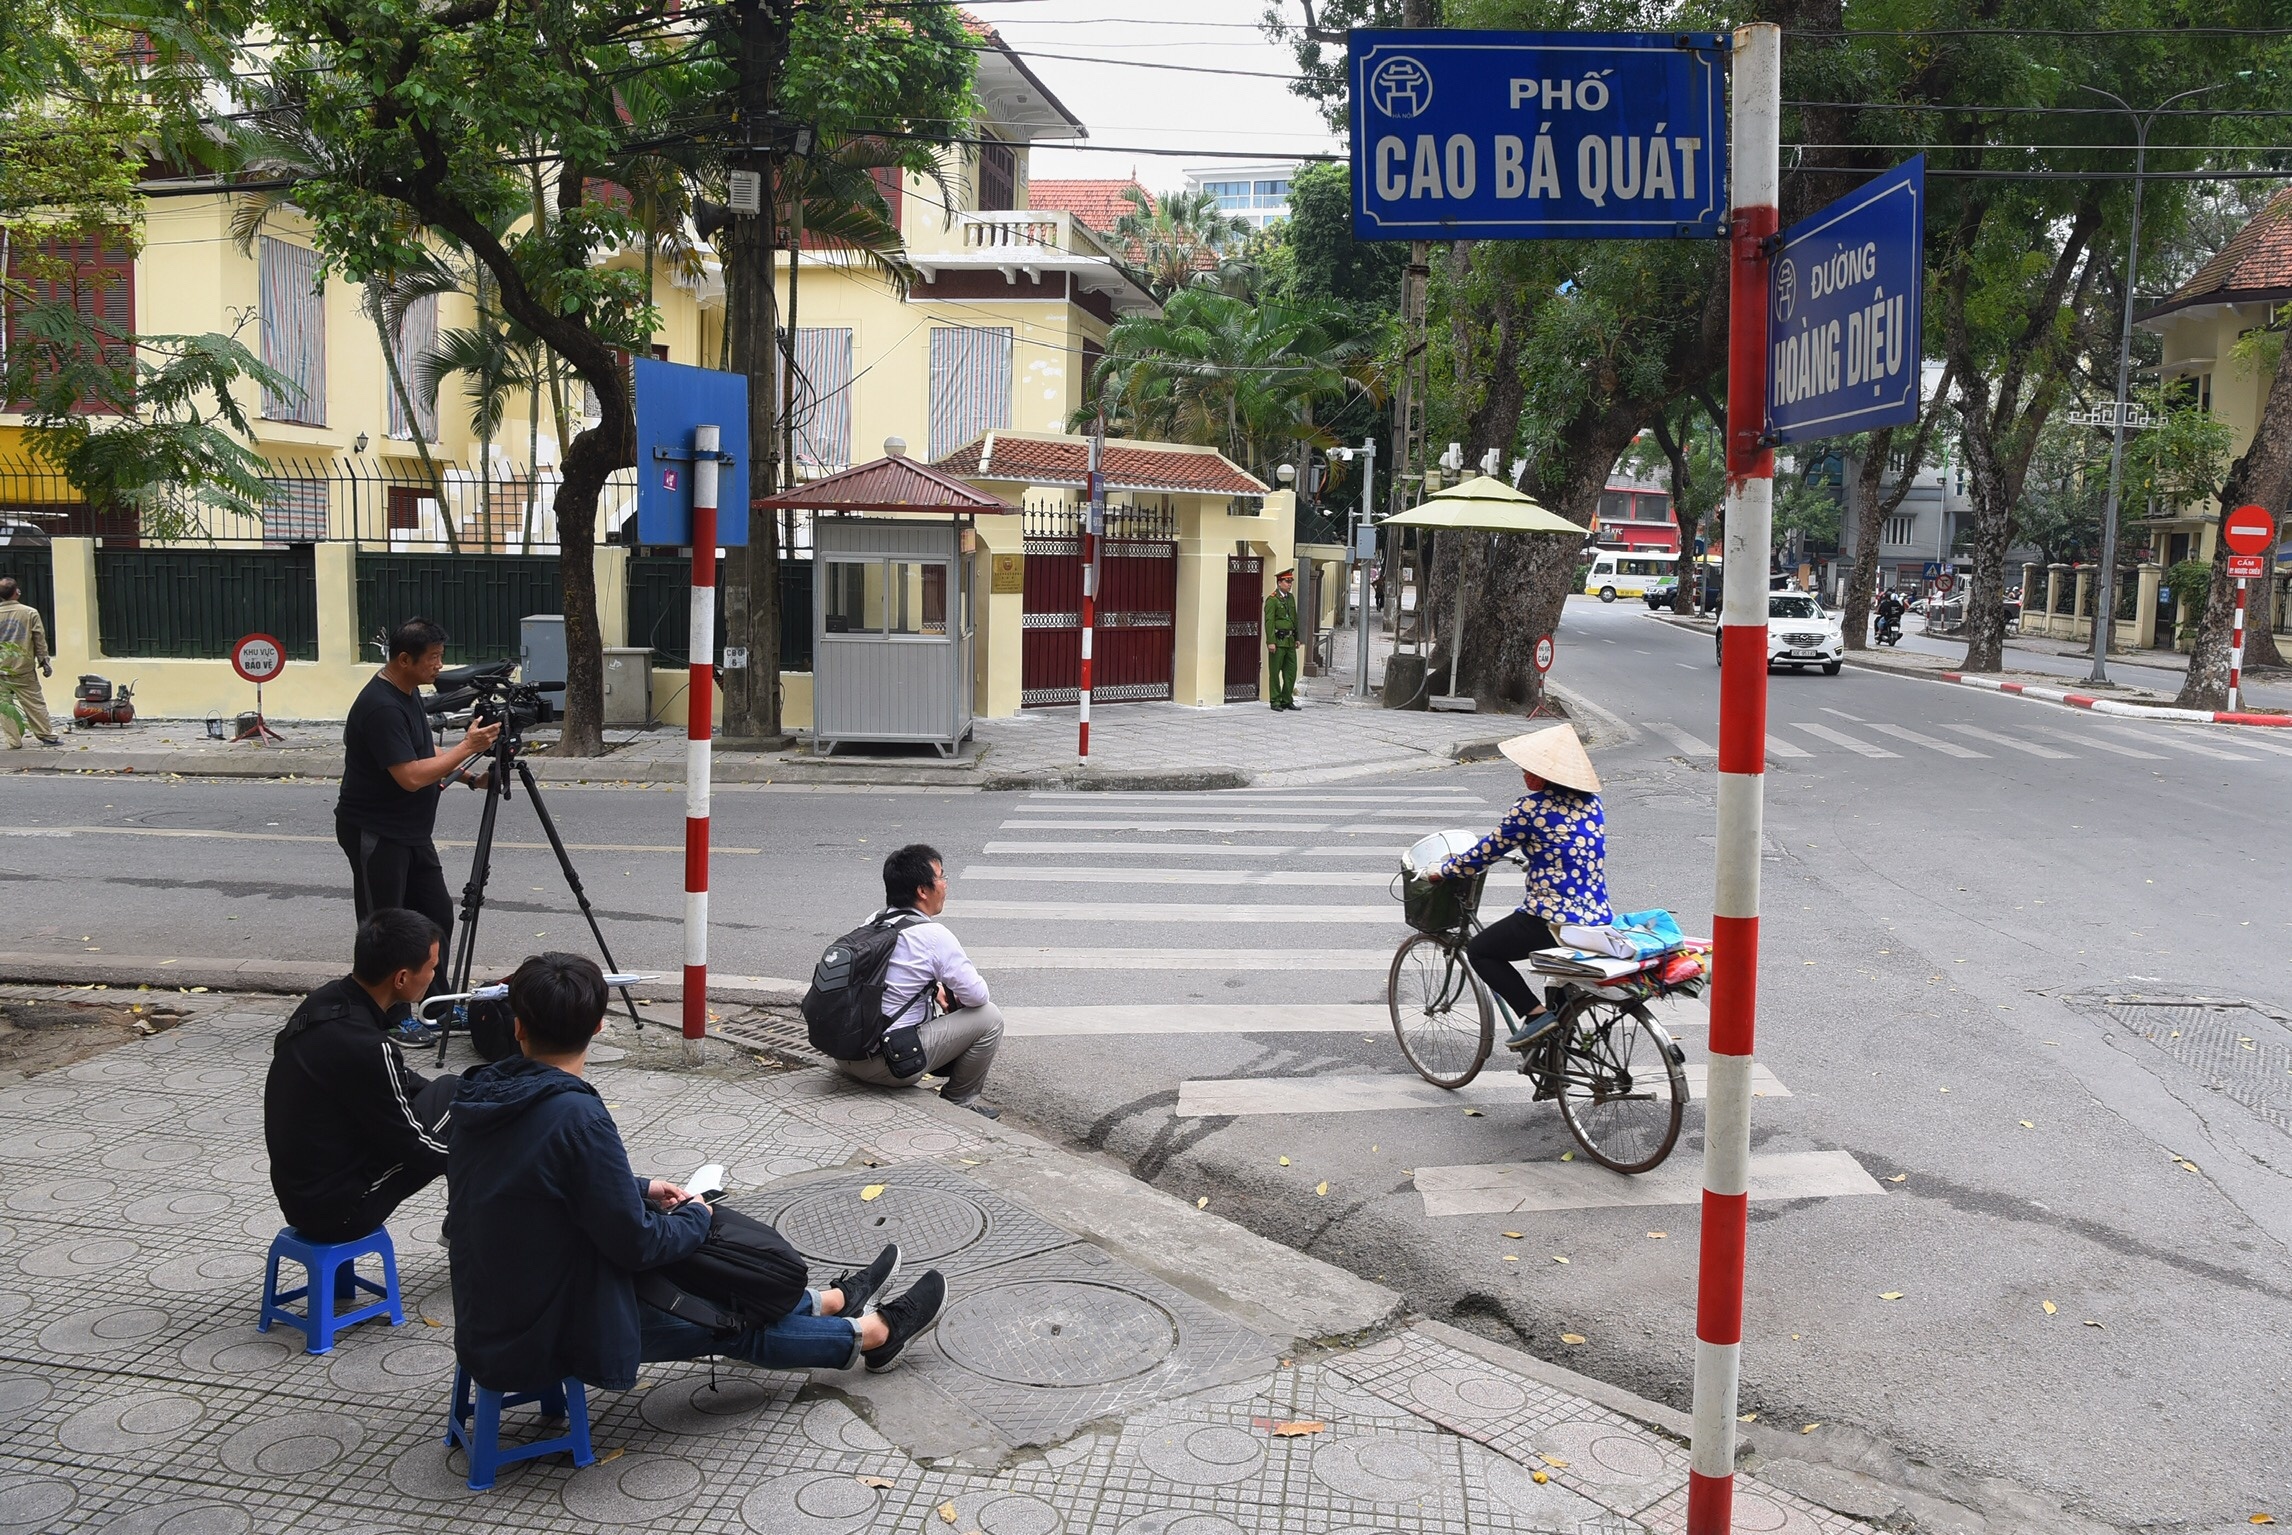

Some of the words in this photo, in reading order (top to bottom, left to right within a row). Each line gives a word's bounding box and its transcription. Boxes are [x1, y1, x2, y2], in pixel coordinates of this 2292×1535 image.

[1509, 69, 1615, 110] PHỐ
[1375, 134, 1476, 202] CAO
[1495, 122, 1561, 200] BÁ
[1577, 122, 1701, 207] QUÁT
[1811, 241, 1876, 300] ĐƯỜNG
[1774, 317, 1840, 407] HOÀNG
[1847, 286, 1903, 396] DIỆU
[243, 648, 258, 656] KHU
[260, 648, 275, 657] VỰC
[245, 658, 261, 670] BẢO
[263, 659, 273, 670] VỆ
